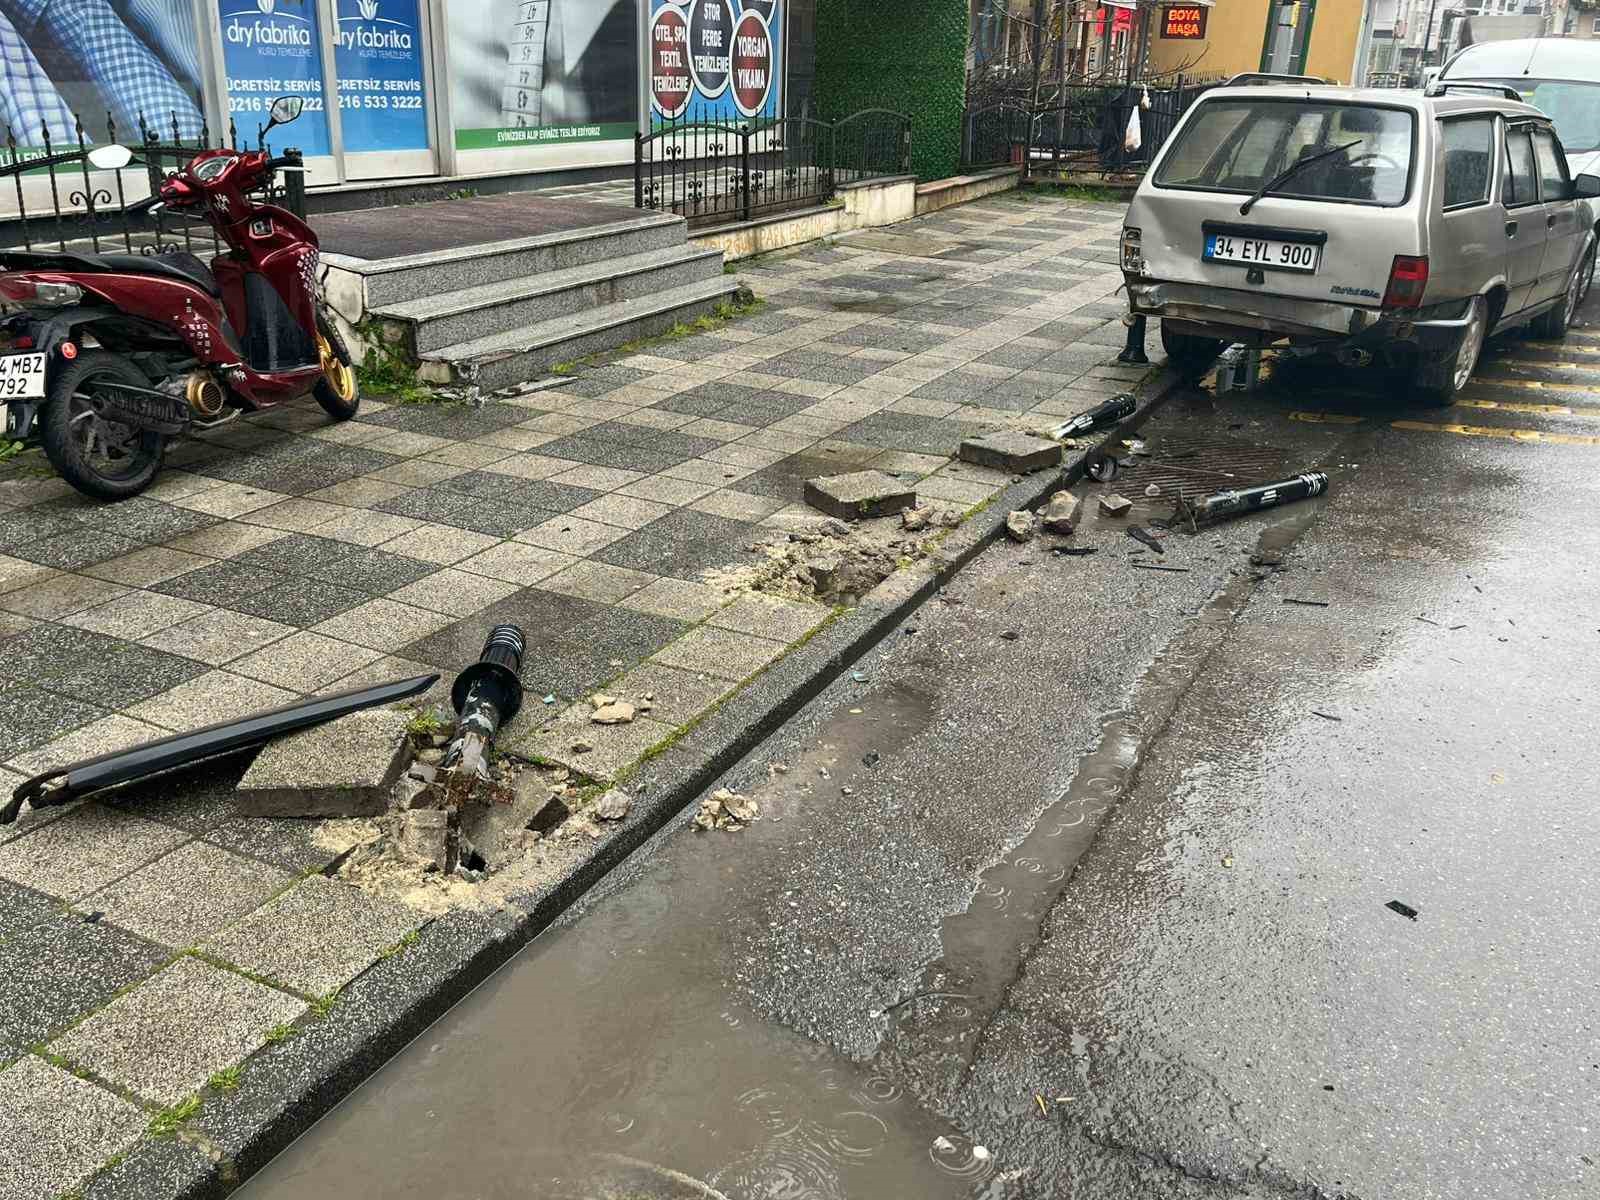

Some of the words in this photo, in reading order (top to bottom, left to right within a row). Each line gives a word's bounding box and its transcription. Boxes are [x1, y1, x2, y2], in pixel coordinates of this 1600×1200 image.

[704, 3, 721, 21] STOR
[1168, 9, 1200, 21] BOYA
[338, 26, 412, 50] ryfabrika
[675, 26, 687, 42] SPA
[702, 29, 722, 47] PERDE
[1166, 23, 1200, 37] MAŞA
[737, 36, 767, 57] YORGAN
[660, 47, 683, 68] TEXTİL
[694, 51, 729, 73] TEMİZLEME
[225, 75, 282, 92] ÜCRETSİZ
[284, 77, 322, 92] SERVİS
[337, 77, 381, 91] CRETSİZ
[384, 78, 421, 91] SERVİS
[654, 72, 689, 92] TEMİZLEME
[737, 68, 766, 89] YIKAMA
[229, 97, 262, 112] 0216
[301, 97, 324, 111] 222
[337, 95, 361, 108] 216
[364, 95, 388, 108] 533
[391, 96, 422, 109] 3222
[1215, 237, 1234, 258] 34
[1242, 240, 1272, 263] EYL
[1280, 244, 1313, 267] 900
[11, 356, 43, 374] MBZ
[0, 377, 27, 395] 792
